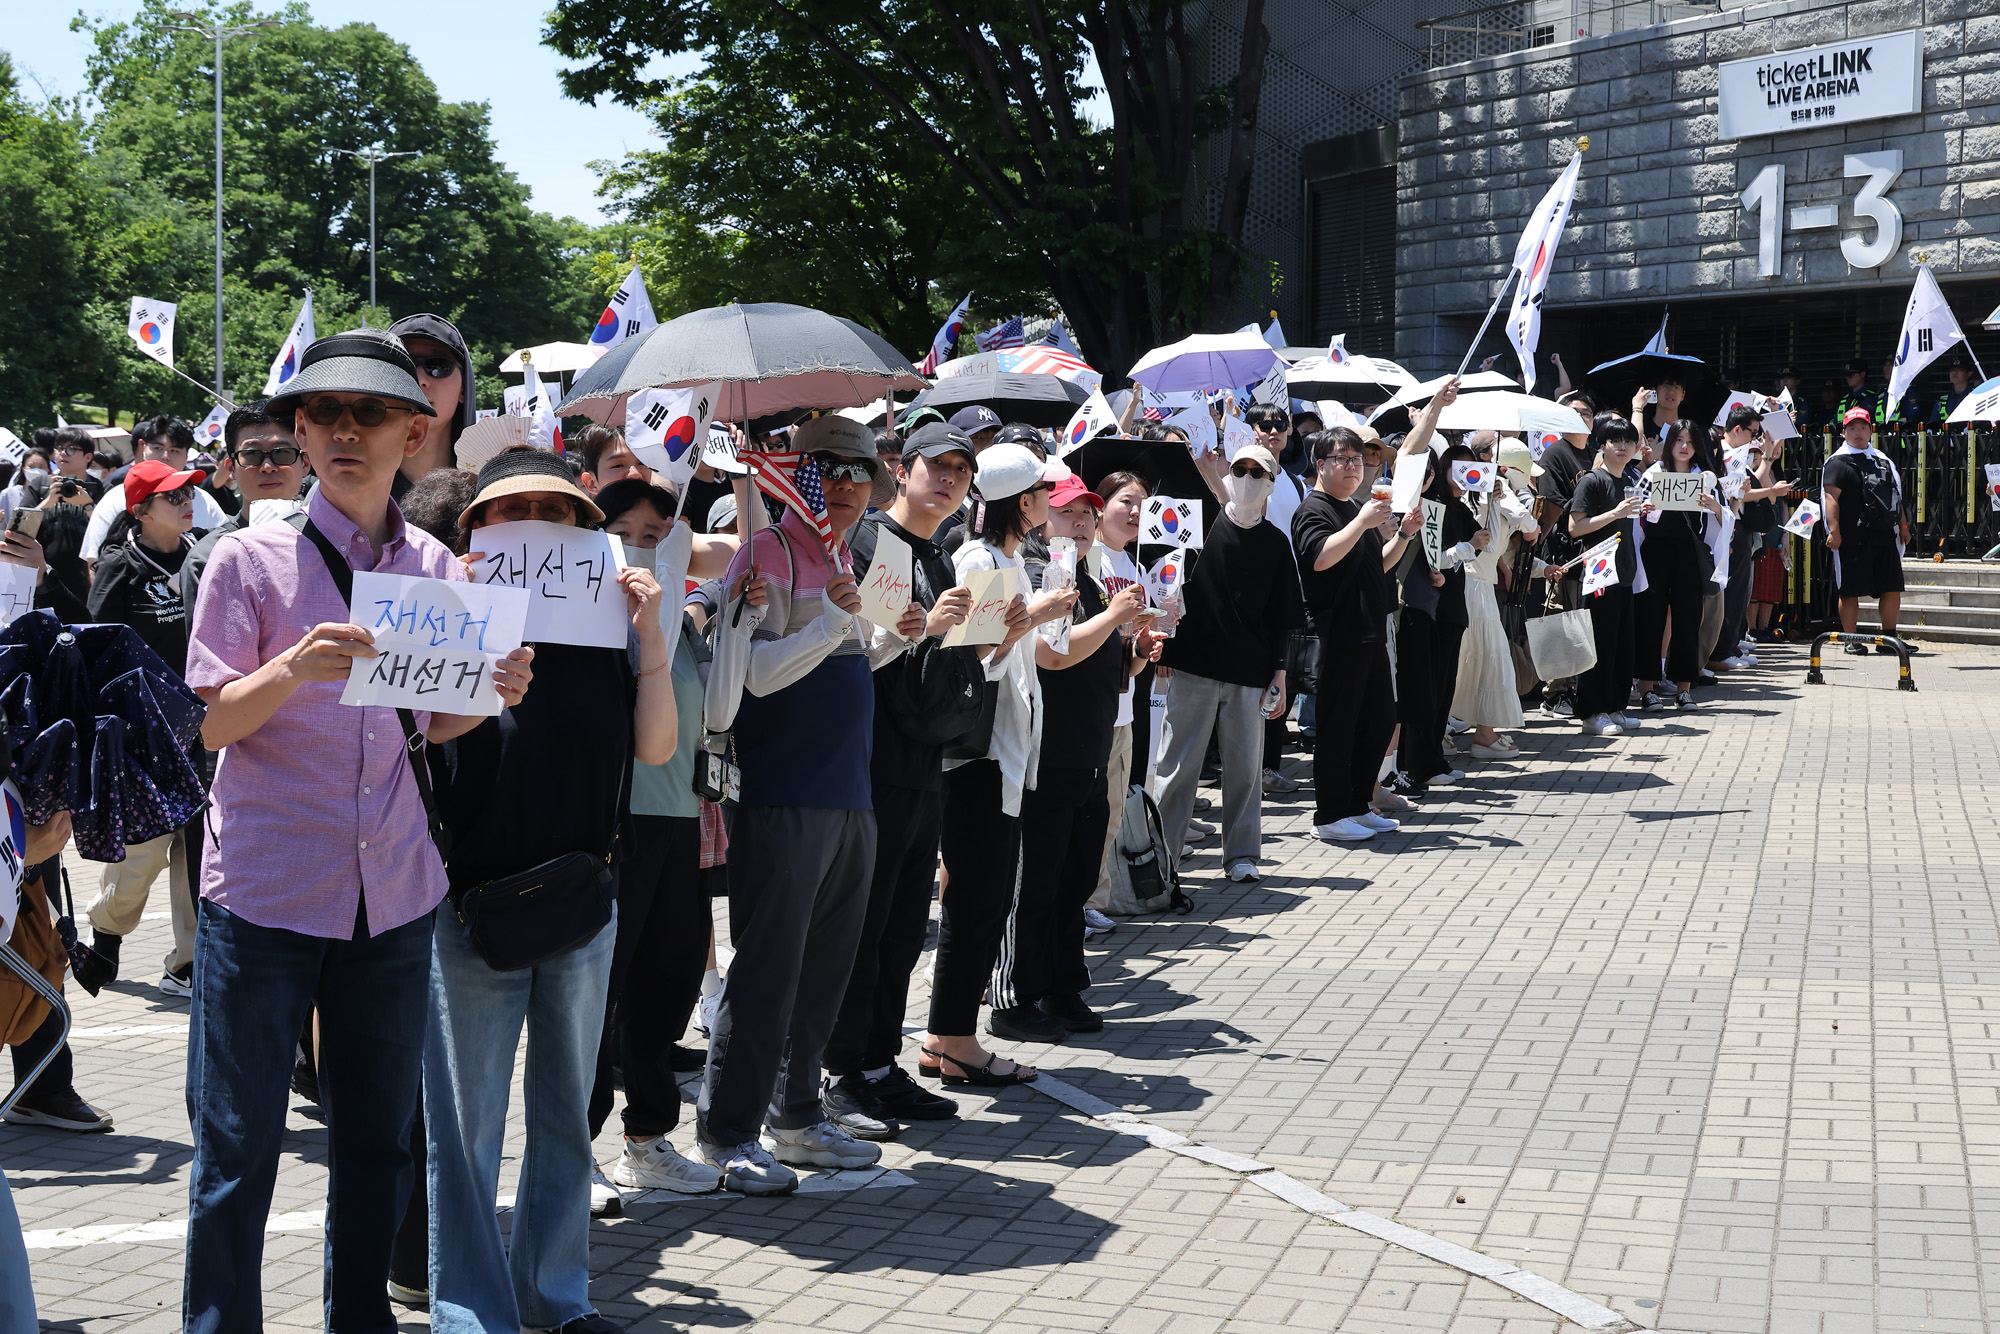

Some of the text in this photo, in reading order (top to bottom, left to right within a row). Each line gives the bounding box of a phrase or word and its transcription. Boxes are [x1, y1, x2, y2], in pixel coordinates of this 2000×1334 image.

[1757, 47, 1873, 88] ticketLINK
[1767, 77, 1860, 105] LIVE ARENA
[1791, 105, 1835, 120] 핸드볼 경기장
[1740, 150, 1903, 277] 1-3
[977, 407, 994, 422] NY
[1652, 478, 1704, 502] 재선거
[485, 543, 605, 603] 재선거
[155, 606, 175, 616] World
[374, 600, 492, 650] 재선거
[369, 651, 485, 698] 재선거
